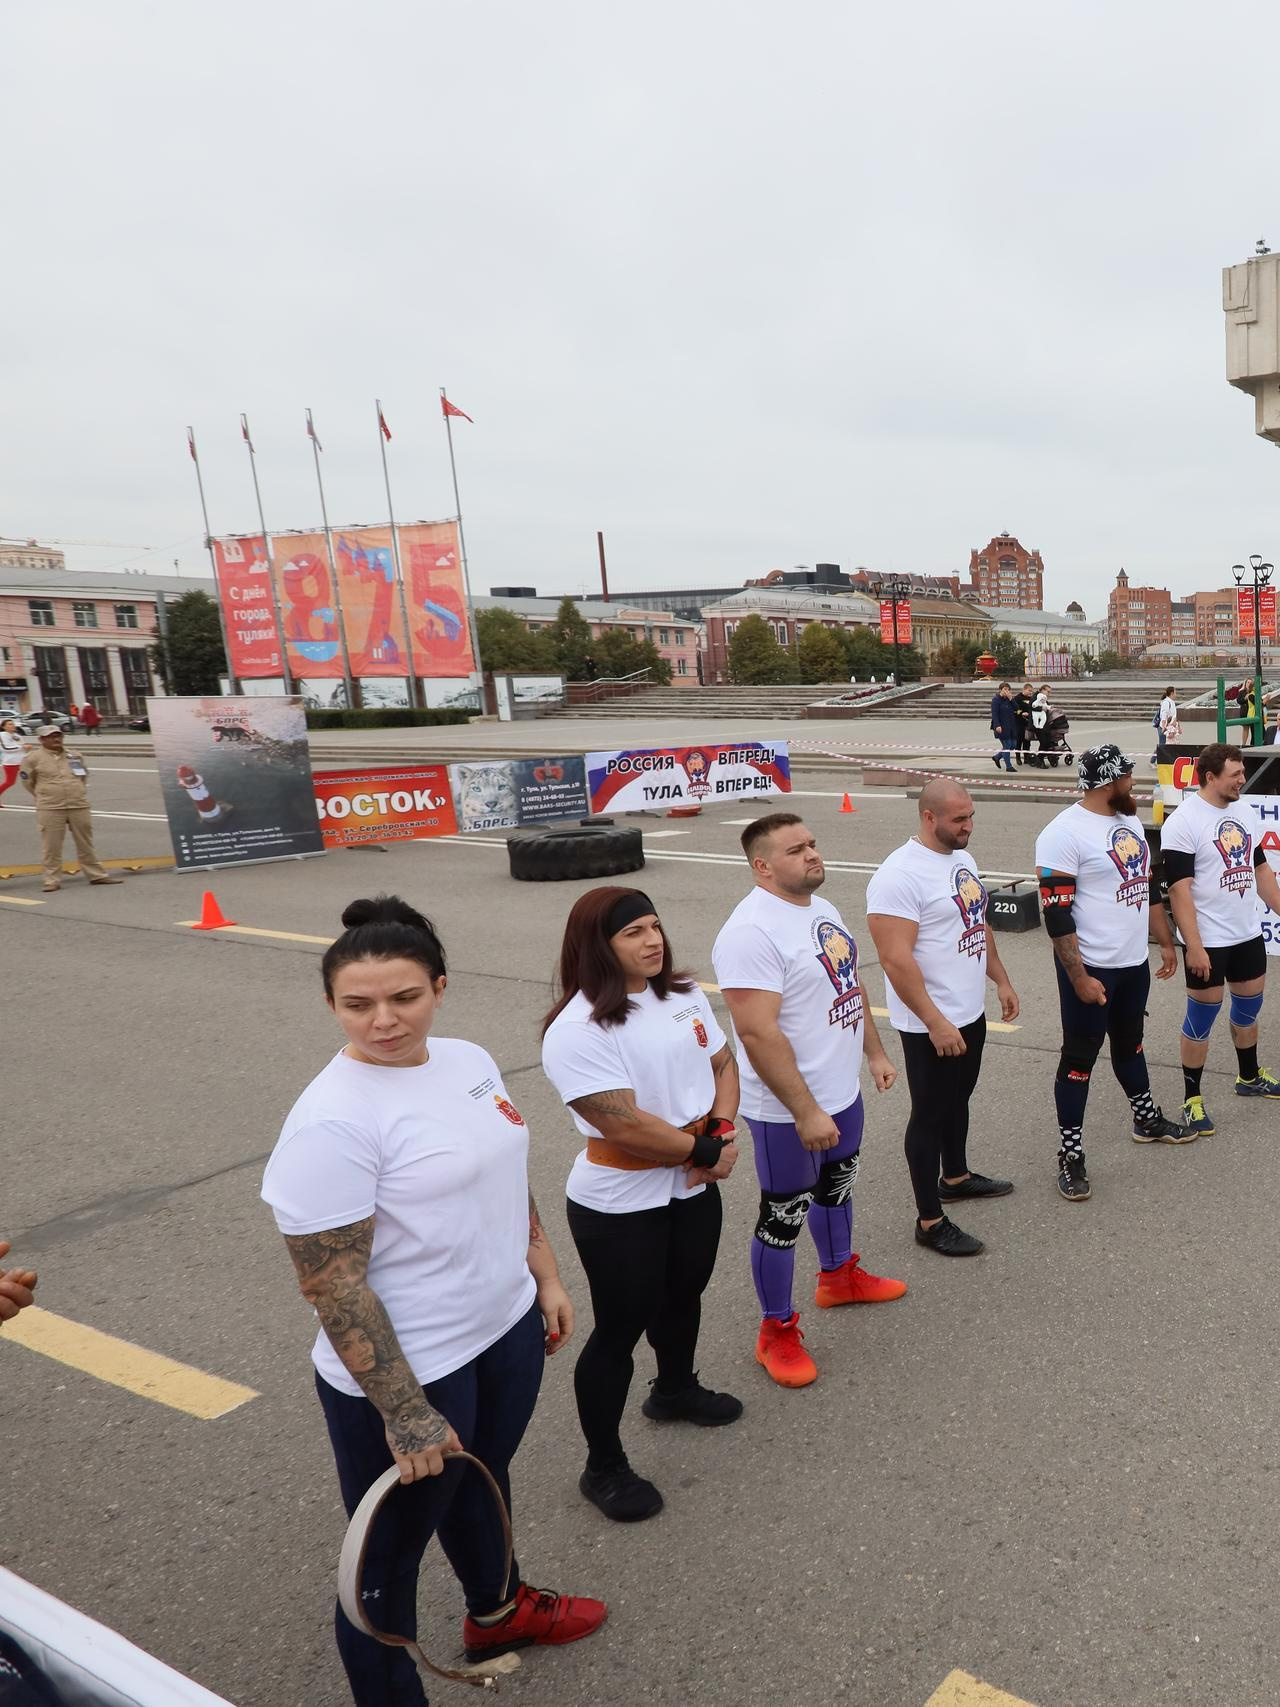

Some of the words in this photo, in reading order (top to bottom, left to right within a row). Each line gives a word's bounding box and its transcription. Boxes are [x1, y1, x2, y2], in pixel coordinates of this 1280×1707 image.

[230, 586, 239, 600] С
[607, 754, 675, 775] РОССИЯ
[718, 748, 776, 766] ВПЕРЕД!
[643, 784, 683, 801] ТУЛА
[715, 775, 772, 794] ВПЕРЕД!
[994, 902, 1017, 914] 220
